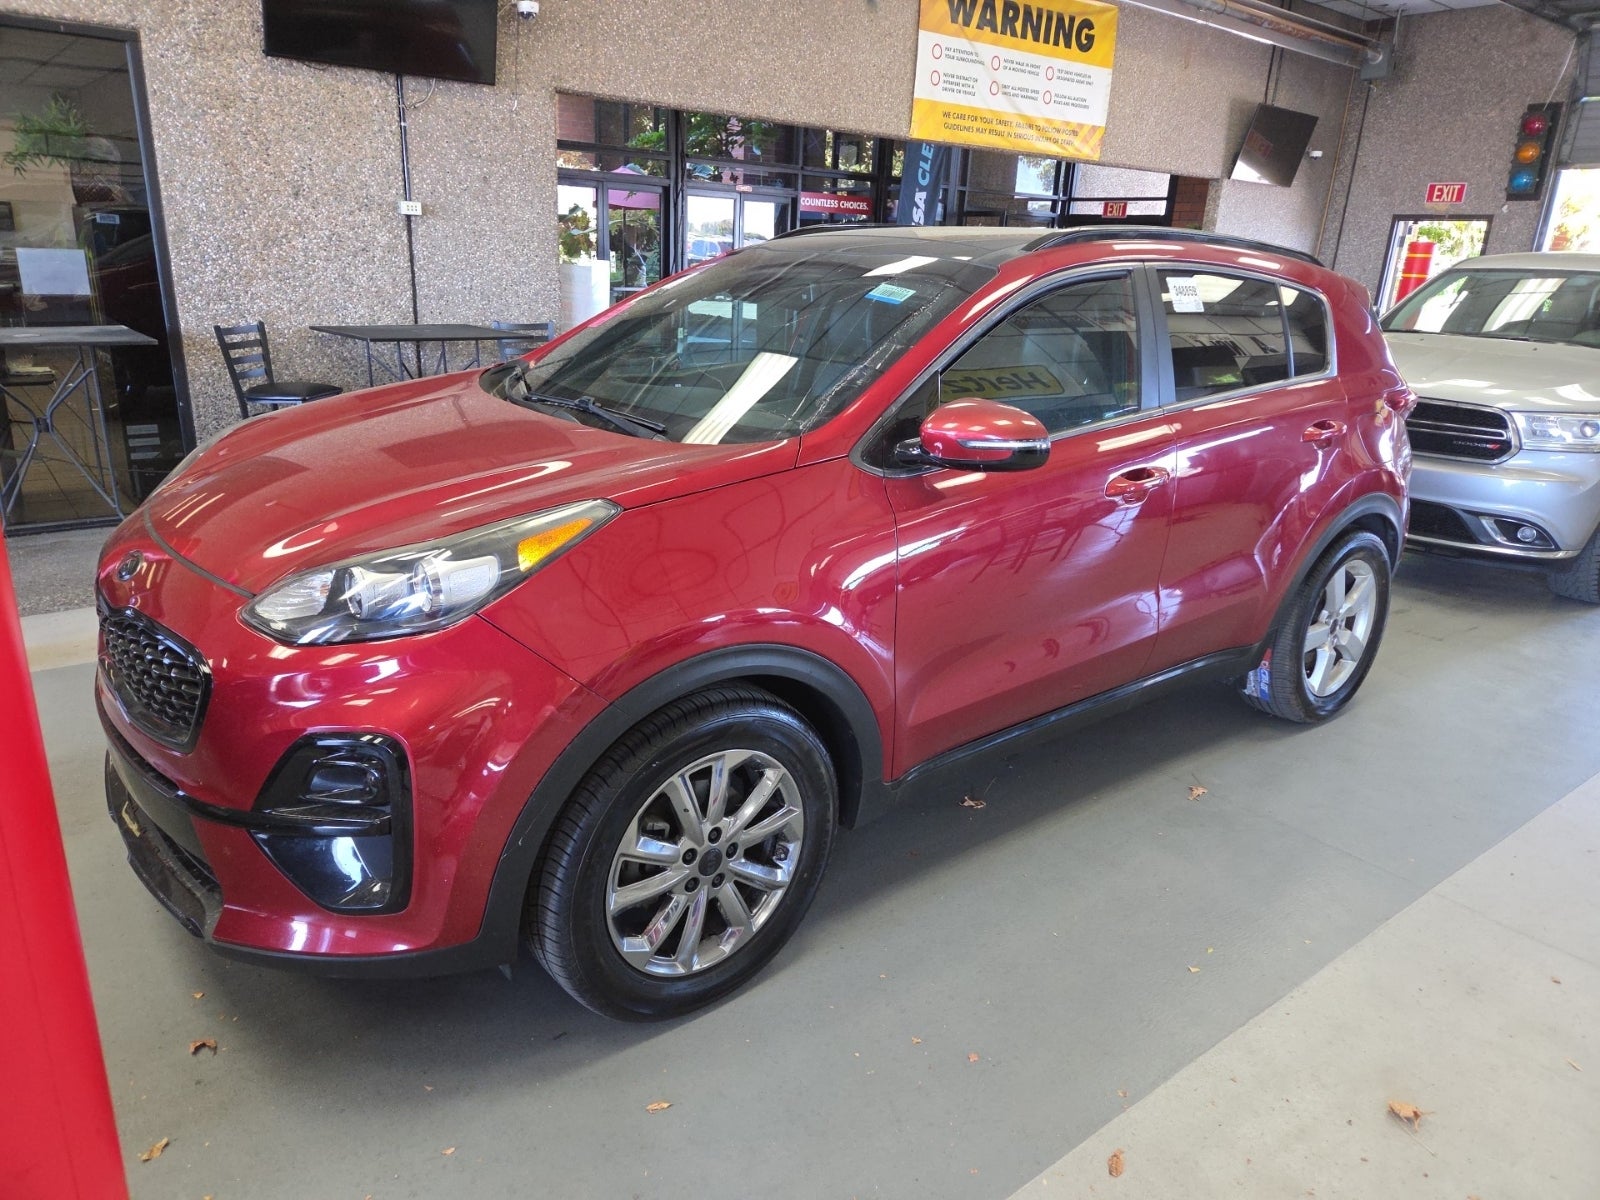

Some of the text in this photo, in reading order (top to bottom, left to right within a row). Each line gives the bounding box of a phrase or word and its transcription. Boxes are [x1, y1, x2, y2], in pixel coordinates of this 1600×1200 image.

[948, 0, 1096, 53] WARNING
[943, 111, 951, 119] WE
[952, 112, 966, 121] CARE
[967, 114, 978, 122] FOR
[980, 116, 994, 124] YOUR
[943, 122, 974, 133] GUIDELINES
[975, 126, 987, 134] MAY
[988, 128, 1005, 137] RESULT
[911, 142, 935, 226] SA CLE
[1432, 184, 1462, 202] EXIT
[800, 197, 869, 211] COUNTLESS CHOICES.
[1107, 201, 1125, 216] EXIT
